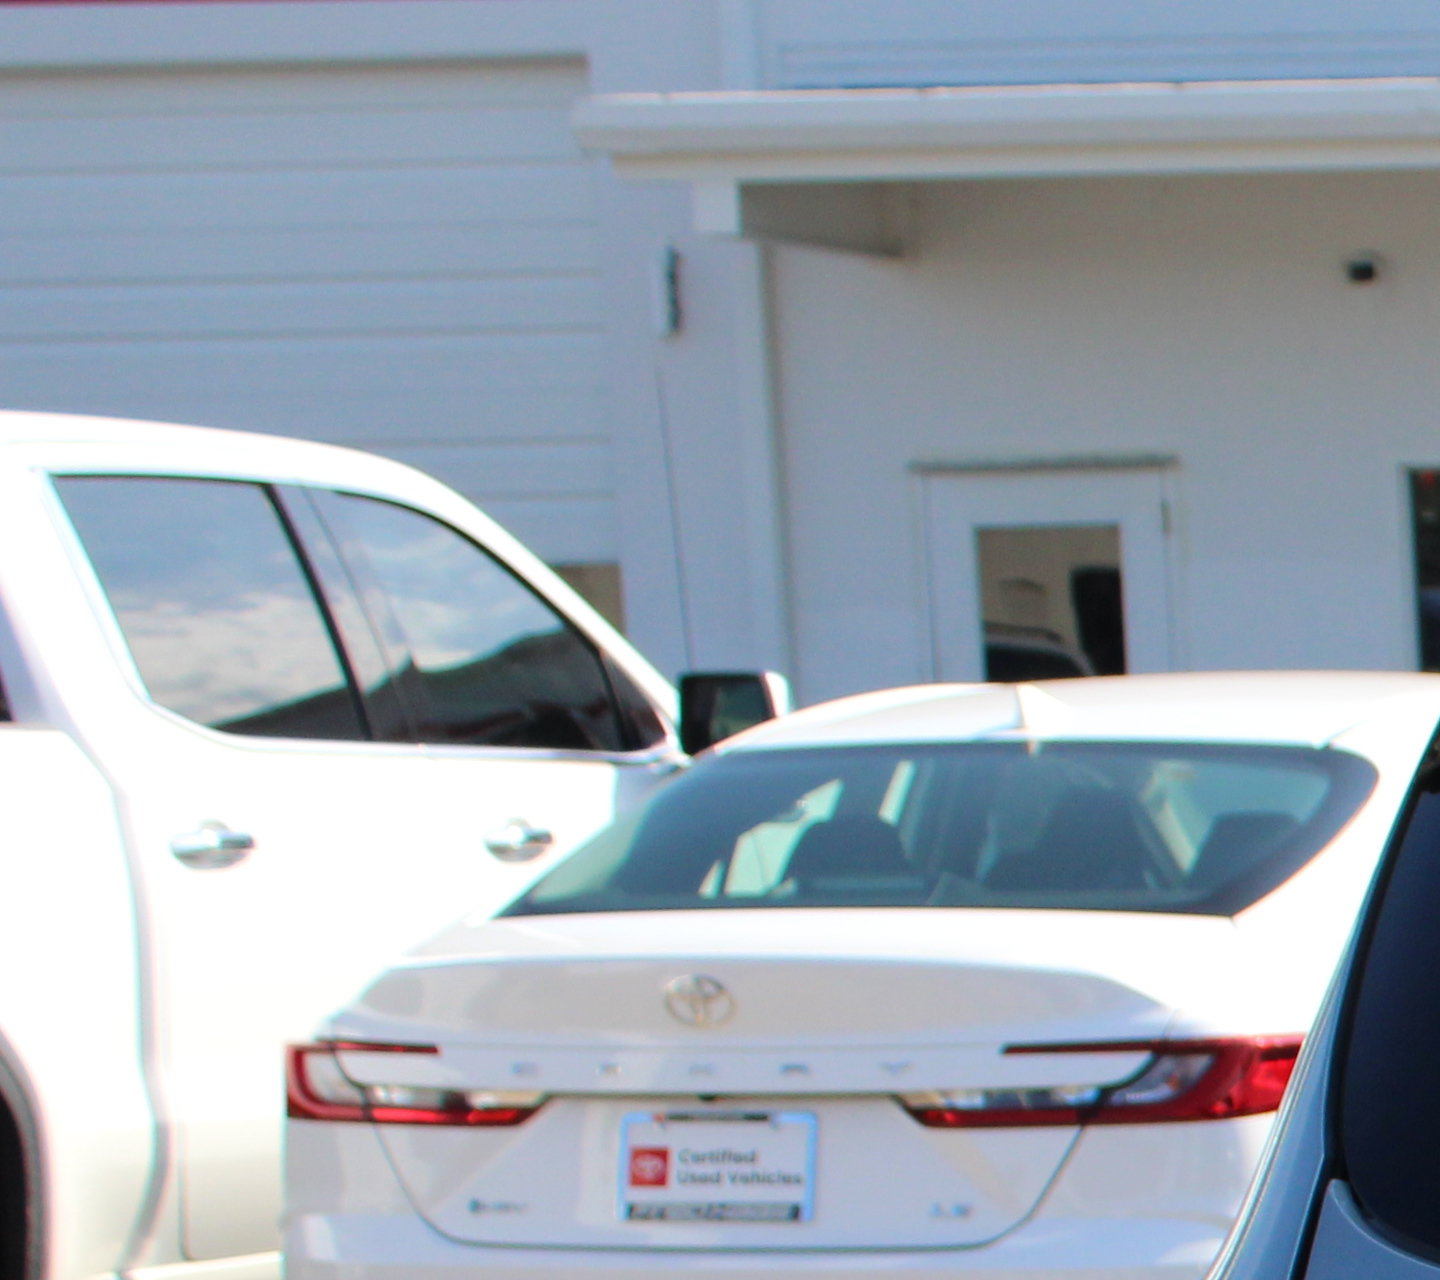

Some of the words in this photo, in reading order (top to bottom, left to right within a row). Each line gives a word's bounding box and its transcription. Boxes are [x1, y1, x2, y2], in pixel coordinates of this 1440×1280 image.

[677, 1148, 757, 1164] Certified
[677, 1170, 721, 1185] Used
[728, 1170, 804, 1185] Vehicles
